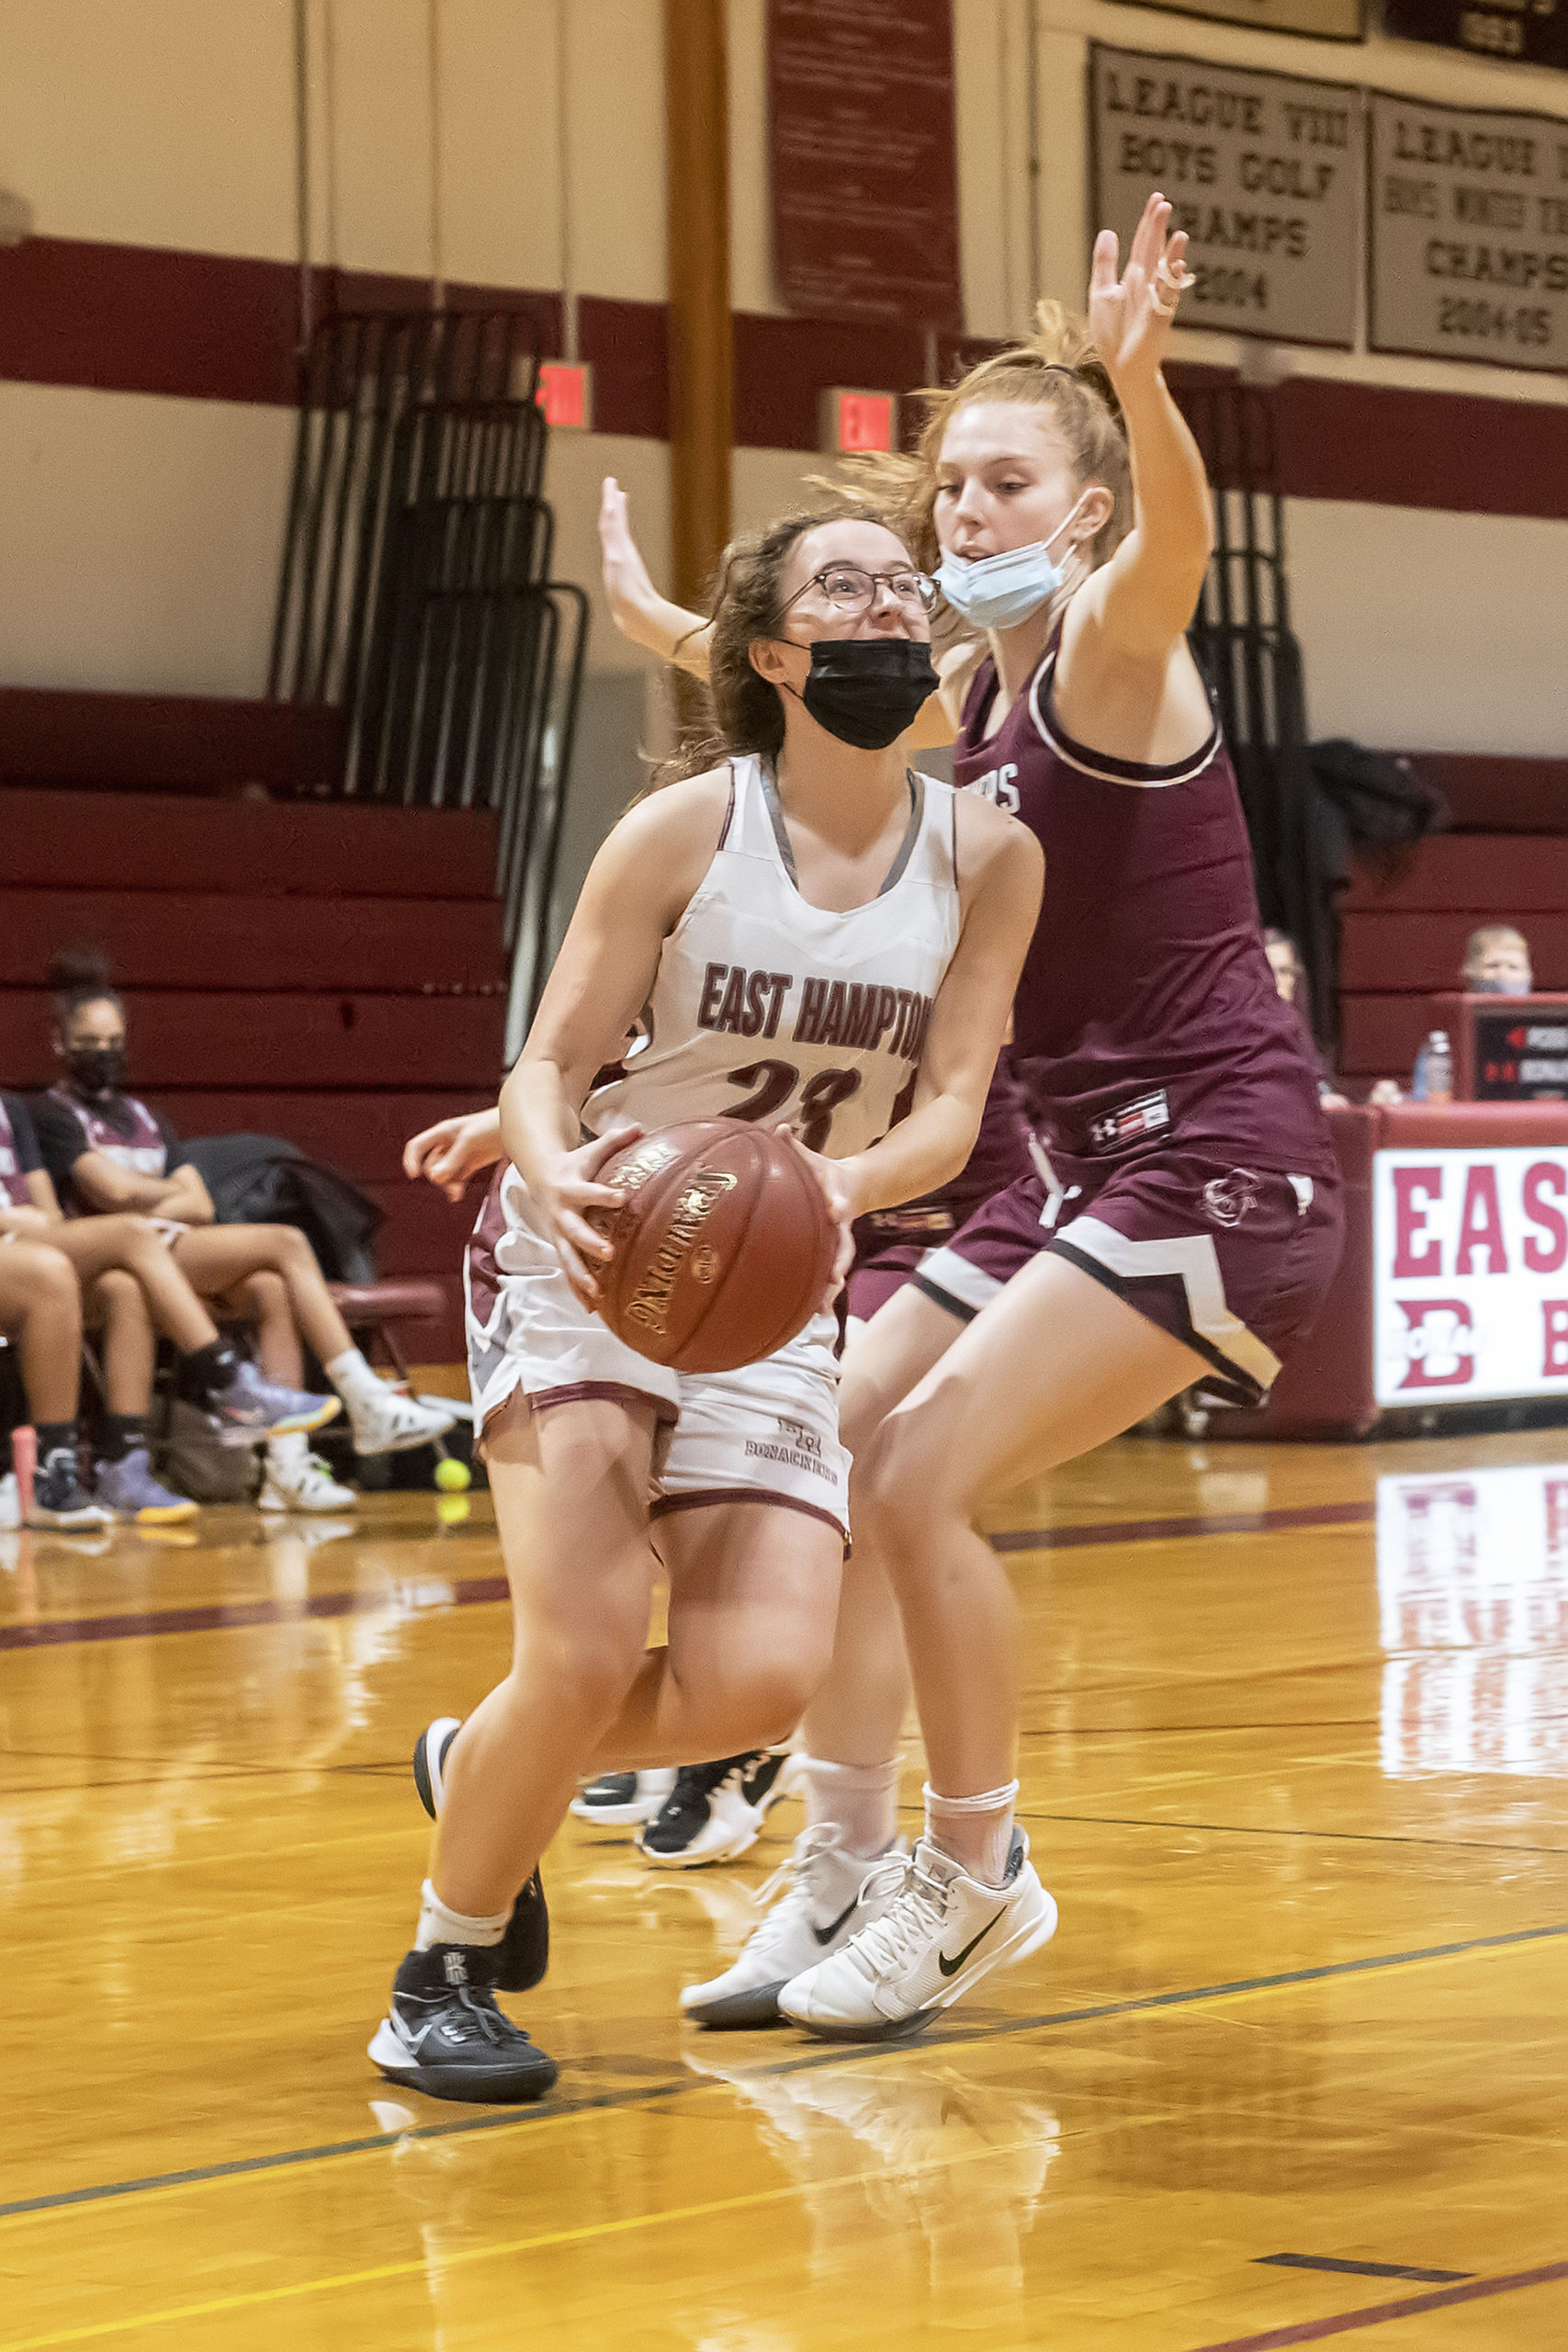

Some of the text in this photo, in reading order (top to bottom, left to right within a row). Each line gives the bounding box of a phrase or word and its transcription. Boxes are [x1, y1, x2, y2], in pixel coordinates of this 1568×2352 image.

[1105, 70, 1263, 136] LEAGUE
[1120, 131, 1335, 200] BOYS GOLF
[1393, 119, 1537, 176] LEAGUE
[697, 961, 794, 1040] EAST
